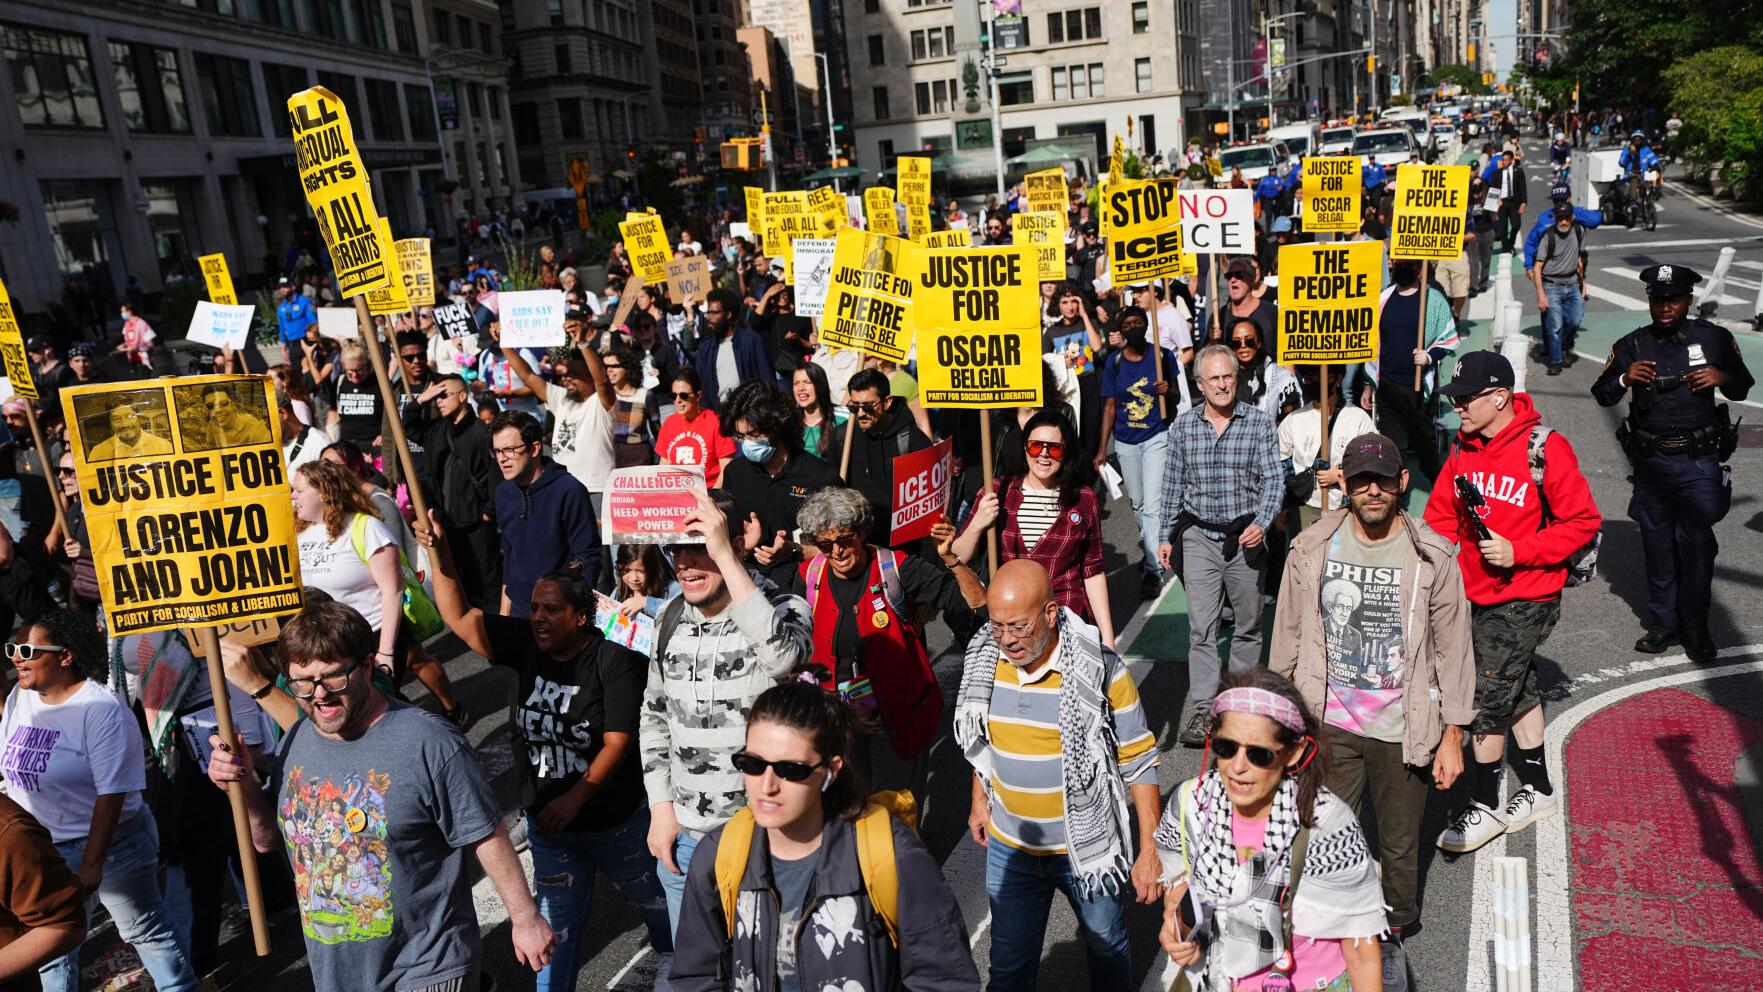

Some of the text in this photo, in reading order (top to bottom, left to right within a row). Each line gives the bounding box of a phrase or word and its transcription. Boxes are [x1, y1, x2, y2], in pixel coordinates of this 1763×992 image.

[1307, 160, 1353, 176] JUSTICE
[1321, 176, 1342, 191] FOR
[1421, 169, 1447, 188] THE
[765, 195, 801, 204] FULL
[807, 188, 830, 207] REE
[1029, 191, 1065, 201] JUSTICE FOR
[1111, 181, 1174, 228] STOP
[1312, 197, 1351, 212] OSCAR
[1406, 189, 1458, 208] PEOPLE
[765, 203, 803, 215] AND EQUAL
[1179, 194, 1227, 219] NO
[330, 192, 372, 241] ALL
[801, 216, 818, 231] ALL
[1017, 214, 1057, 230] JUSTICE
[1317, 212, 1344, 223] BELGAL
[1397, 215, 1461, 235] DEMAND
[625, 220, 658, 238] JUSTICE
[636, 235, 655, 249] FOR
[947, 233, 966, 247] ALL
[1114, 231, 1178, 261] ICE
[1398, 234, 1457, 248] ABOLISH ICE!
[637, 251, 667, 268] OSCAR
[688, 262, 701, 273] OUT
[1115, 254, 1179, 272] TERROR
[1312, 250, 1350, 275] THE
[403, 273, 431, 287] CE
[835, 266, 890, 292] JUSTICE
[920, 254, 1022, 288] JUSTICE
[1294, 273, 1367, 300] PEOPLE
[432, 301, 471, 326] FUCK
[512, 305, 552, 317] KIDS SAY
[837, 291, 905, 332] PIERRE
[952, 289, 1000, 322] FOR
[445, 320, 470, 338] ICE
[1285, 307, 1373, 334] DEMAND
[835, 317, 897, 347] DAMAS BEL
[1287, 332, 1369, 351] ABOLISH ICE!
[936, 334, 1021, 367] OSCAR
[1284, 352, 1300, 360] PARTY
[1300, 352, 1310, 360] FOR
[1311, 352, 1338, 360] SOCIALISM
[1344, 350, 1372, 359] LIBERATION
[950, 368, 1010, 389] BELGAL
[928, 392, 947, 401] PARTY
[948, 392, 960, 401] FOR
[960, 392, 993, 401] SOCIALISM
[1000, 391, 1035, 401] LIBERATION
[88, 449, 283, 506] JUSTICE FOR
[613, 476, 682, 489] CHALLENGE
[898, 470, 929, 507] ICE
[613, 507, 639, 518] NEED
[896, 504, 920, 526] OUR
[117, 503, 269, 559] LORENZO
[637, 520, 674, 531] POWER
[112, 544, 294, 606] AND JOAN!
[1363, 584, 1400, 594] FLUFFHE
[1363, 593, 1382, 601] WAS
[116, 591, 300, 628] PARTY FOR SOCIALISM & LIBERATION
[1326, 633, 1343, 645] LUFF
[1343, 648, 1353, 656] MY
[1334, 667, 1358, 679] YORK
[525, 675, 581, 715] ART
[8, 725, 61, 751] WORKING
[1, 745, 51, 773] FAMILIES
[6, 768, 41, 793] PARTY
